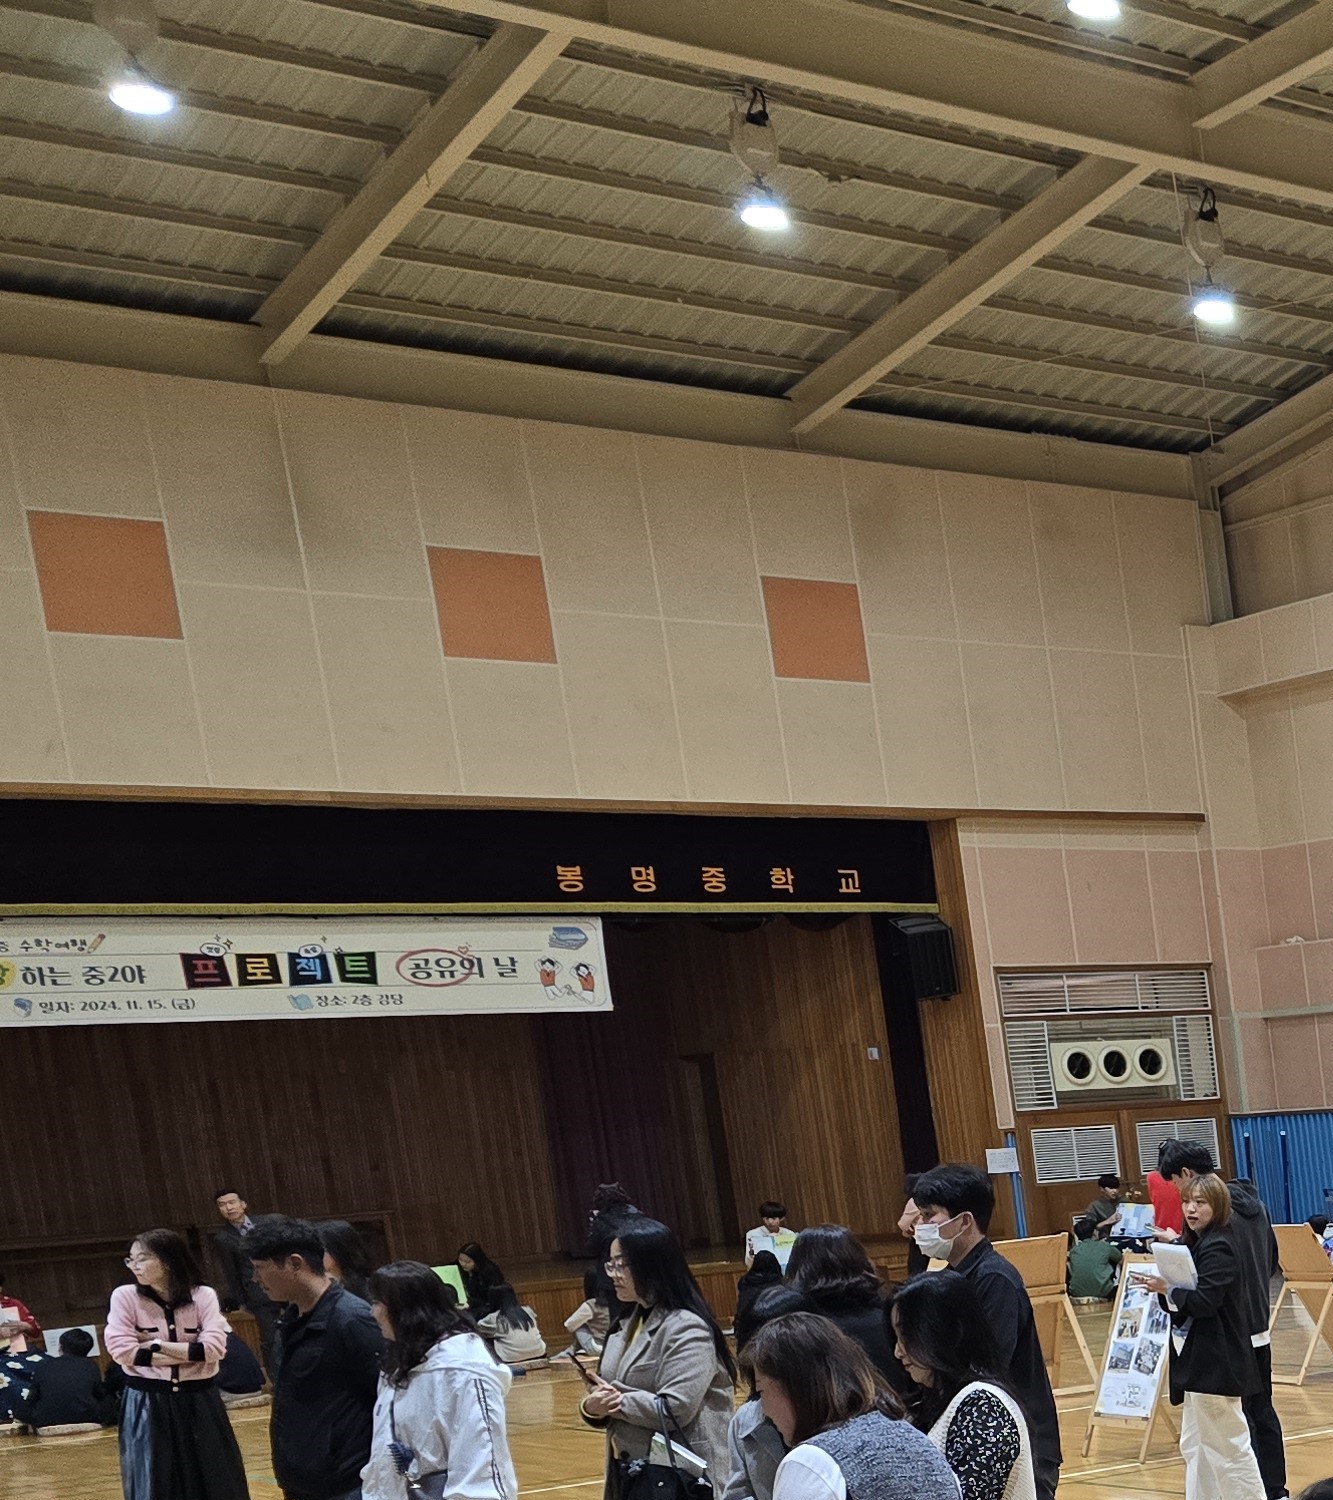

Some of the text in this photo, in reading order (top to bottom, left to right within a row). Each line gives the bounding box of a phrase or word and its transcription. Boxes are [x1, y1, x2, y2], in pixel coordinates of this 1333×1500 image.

[19, 938, 88, 953] 수학여행
[20, 966, 72, 986] 하는
[82, 965, 146, 985] 중2야
[190, 955, 373, 984] 프로젝트
[408, 957, 485, 980] 공유의
[494, 957, 518, 979] 날
[39, 1000, 75, 1013] 일자:
[80, 1000, 121, 1012] 2024.
[147, 999, 167, 1011] 15.
[171, 997, 195, 1011] (금)
[315, 994, 347, 1007] 장소:
[352, 993, 373, 1006] 2층
